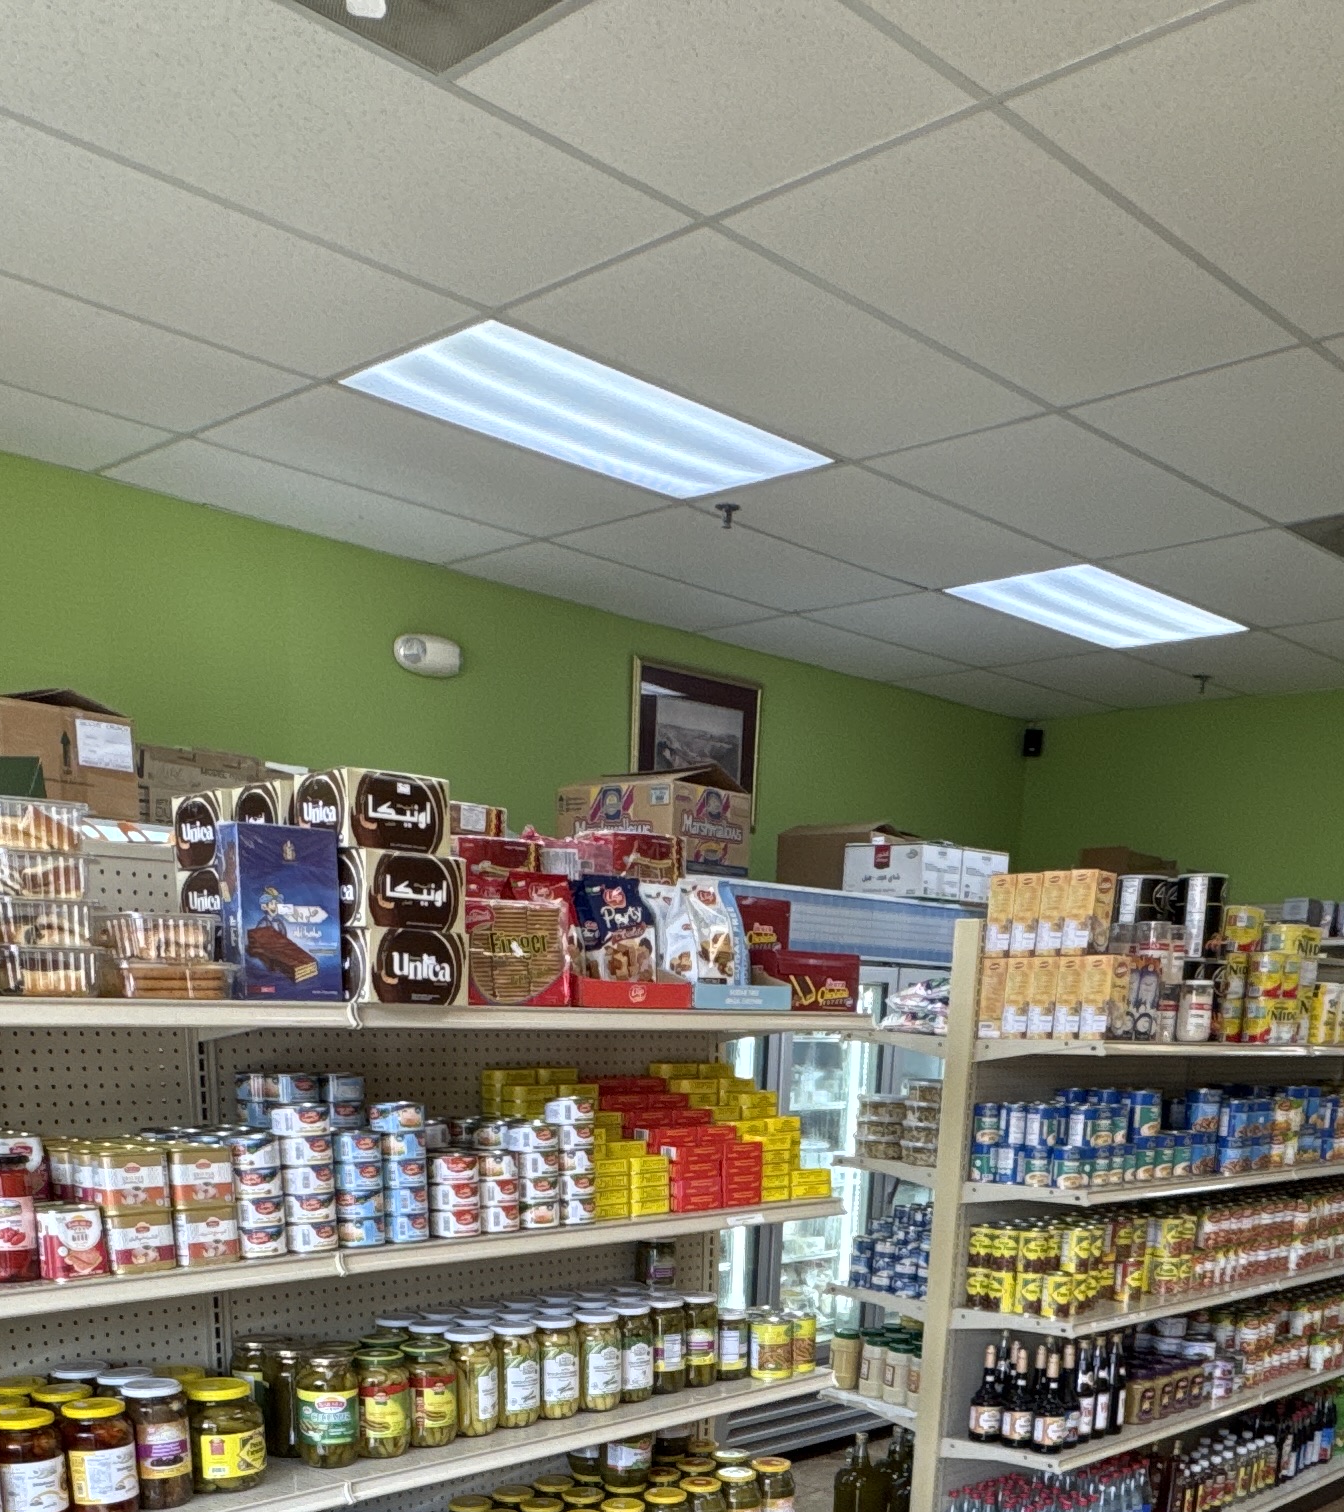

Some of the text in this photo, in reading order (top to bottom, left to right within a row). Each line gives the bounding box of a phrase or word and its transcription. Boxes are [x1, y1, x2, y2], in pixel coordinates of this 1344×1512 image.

[303, 801, 337, 826] Unica
[181, 820, 214, 844] Unica
[188, 889, 220, 913] Unica
[600, 905, 643, 929] Party
[392, 951, 452, 984] Unica
